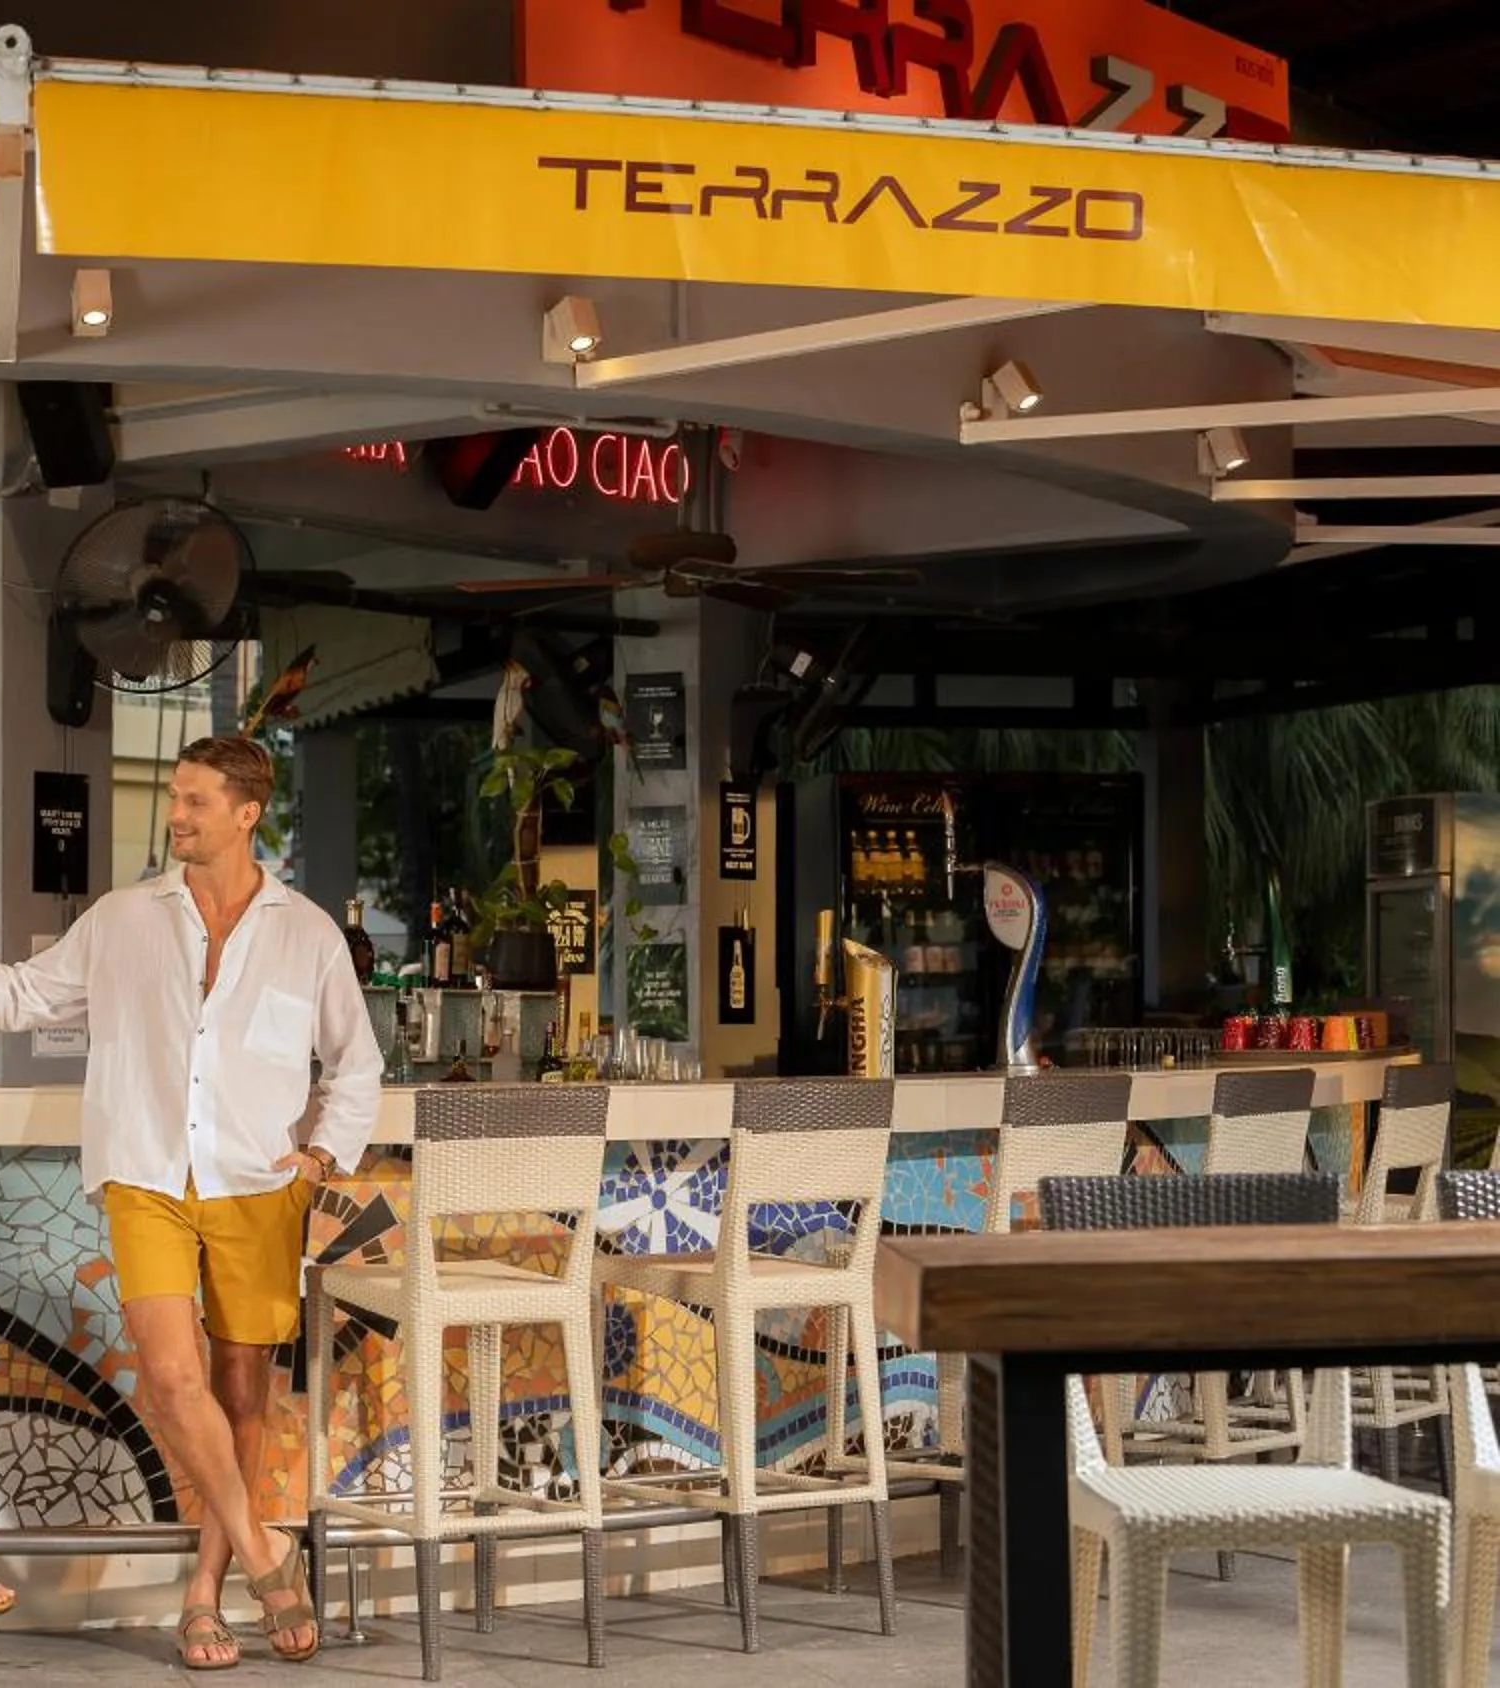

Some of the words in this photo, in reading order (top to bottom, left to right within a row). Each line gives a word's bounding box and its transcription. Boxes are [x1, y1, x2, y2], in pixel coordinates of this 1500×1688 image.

[608, 0, 1290, 141] RRAZZ
[537, 155, 1144, 241] TERRAZZO
[514, 426, 578, 488] AO
[592, 434, 689, 503] CIAO
[851, 993, 867, 1077] INGHA
